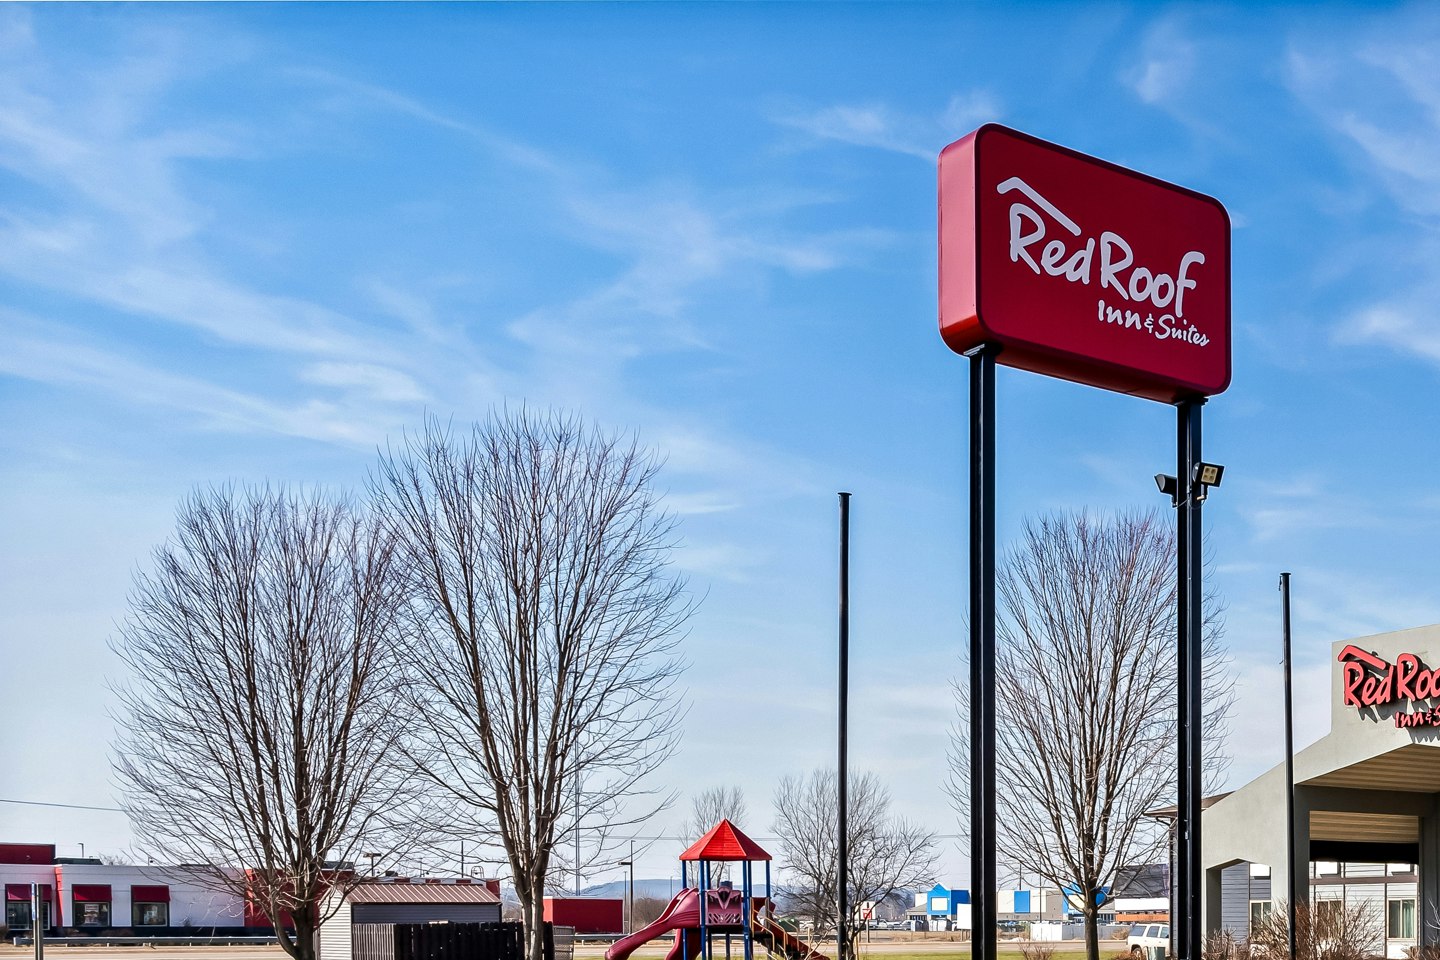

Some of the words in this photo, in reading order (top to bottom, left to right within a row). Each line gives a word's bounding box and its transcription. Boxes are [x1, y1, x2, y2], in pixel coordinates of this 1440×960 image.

[1009, 203, 1096, 284] Red
[1100, 231, 1205, 317] Roof
[1098, 299, 1142, 330] Inn
[1143, 313, 1154, 334] &
[1154, 314, 1210, 347] Suites
[1344, 661, 1394, 708] Red
[1395, 711, 1424, 728] Inn
